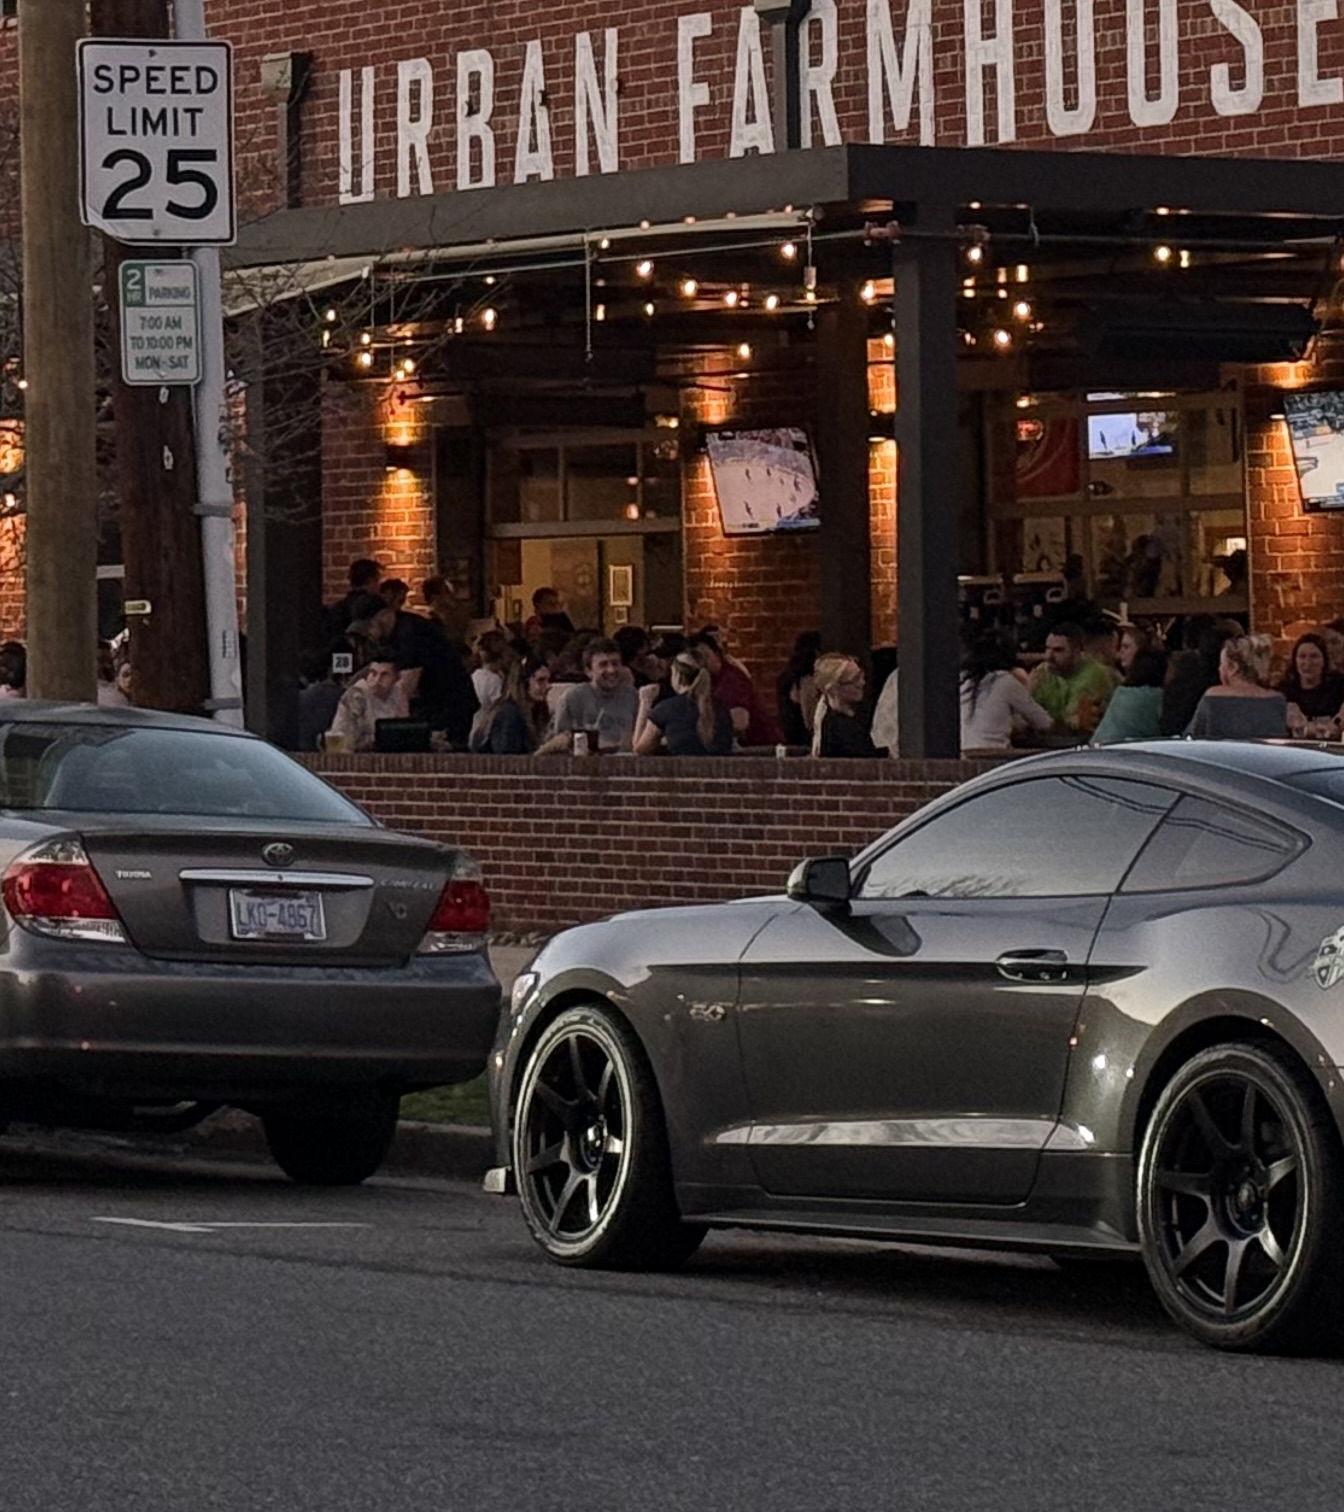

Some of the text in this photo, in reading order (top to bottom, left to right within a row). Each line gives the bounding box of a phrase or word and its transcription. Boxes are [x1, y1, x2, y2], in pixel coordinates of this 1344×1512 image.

[93, 65, 218, 94] SPEED
[107, 107, 204, 136] LIMIT
[338, 27, 619, 205] URBAN
[102, 149, 218, 219] 25
[126, 269, 142, 290] 2
[164, 316, 182, 330] AM
[130, 336, 145, 349] TO
[176, 336, 193, 350] PM
